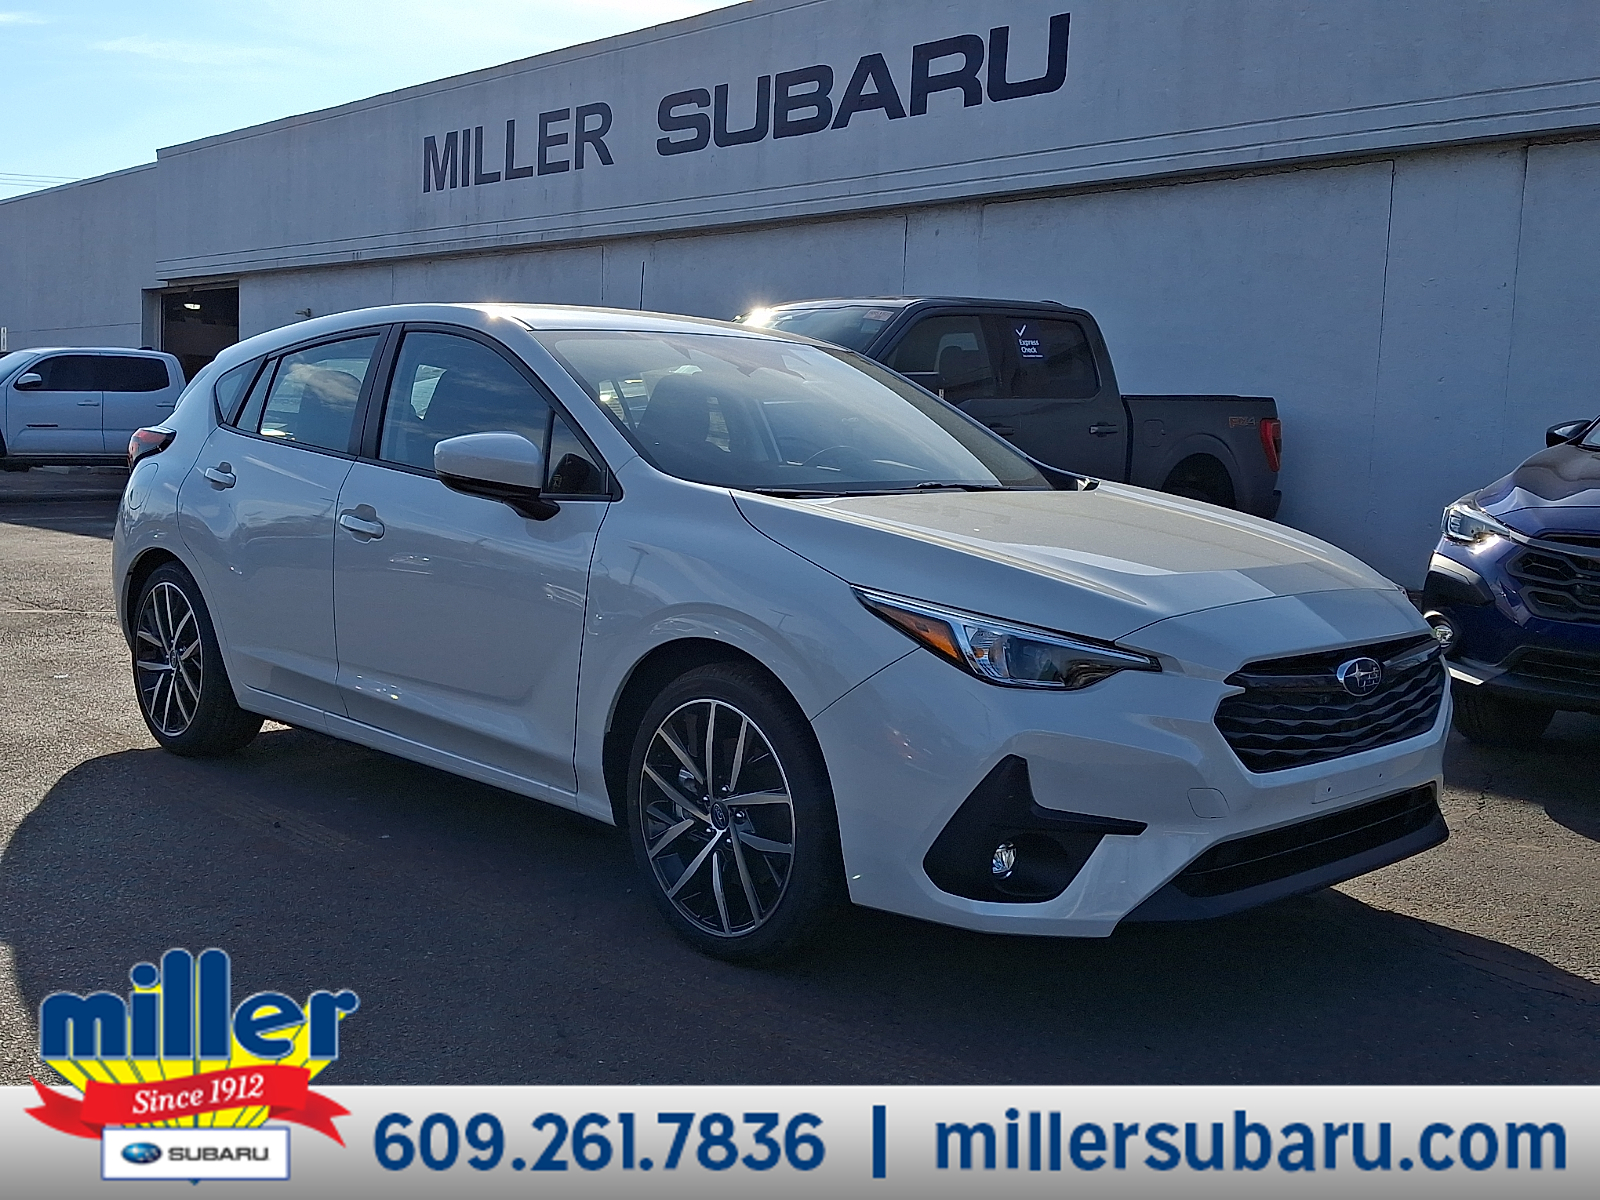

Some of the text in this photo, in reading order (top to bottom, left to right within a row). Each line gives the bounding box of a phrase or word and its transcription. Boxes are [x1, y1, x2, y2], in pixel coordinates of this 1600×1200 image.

[422, 12, 1071, 194] MILLER SUBARU
[1018, 338, 1040, 346] Express
[1020, 346, 1038, 354] Check
